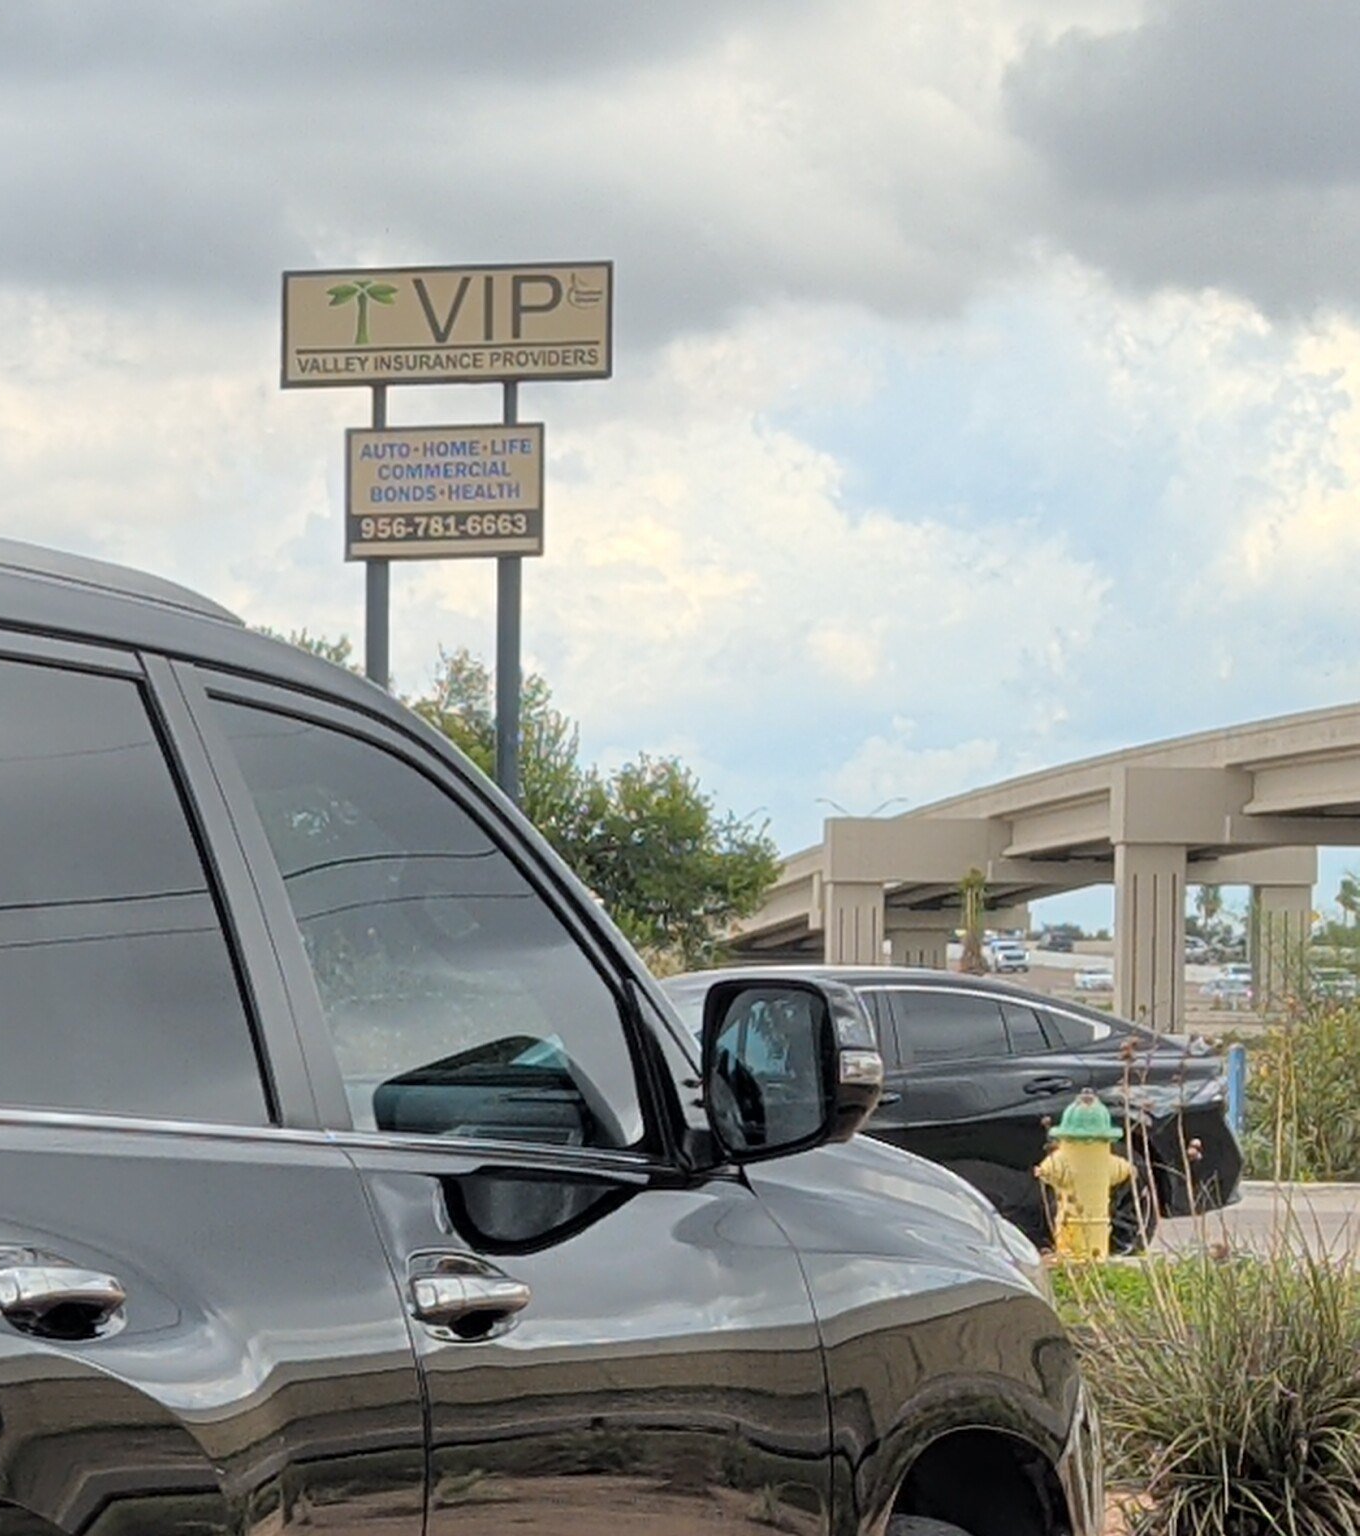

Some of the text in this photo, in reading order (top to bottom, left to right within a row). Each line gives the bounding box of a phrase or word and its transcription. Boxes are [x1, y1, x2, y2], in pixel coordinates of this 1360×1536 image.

[412, 274, 564, 344] VIP
[296, 348, 599, 374] VALLEY INSURANCE PROVIDERS
[377, 461, 511, 480] COMMERCIAL
[360, 513, 528, 539] 956-781-6663
